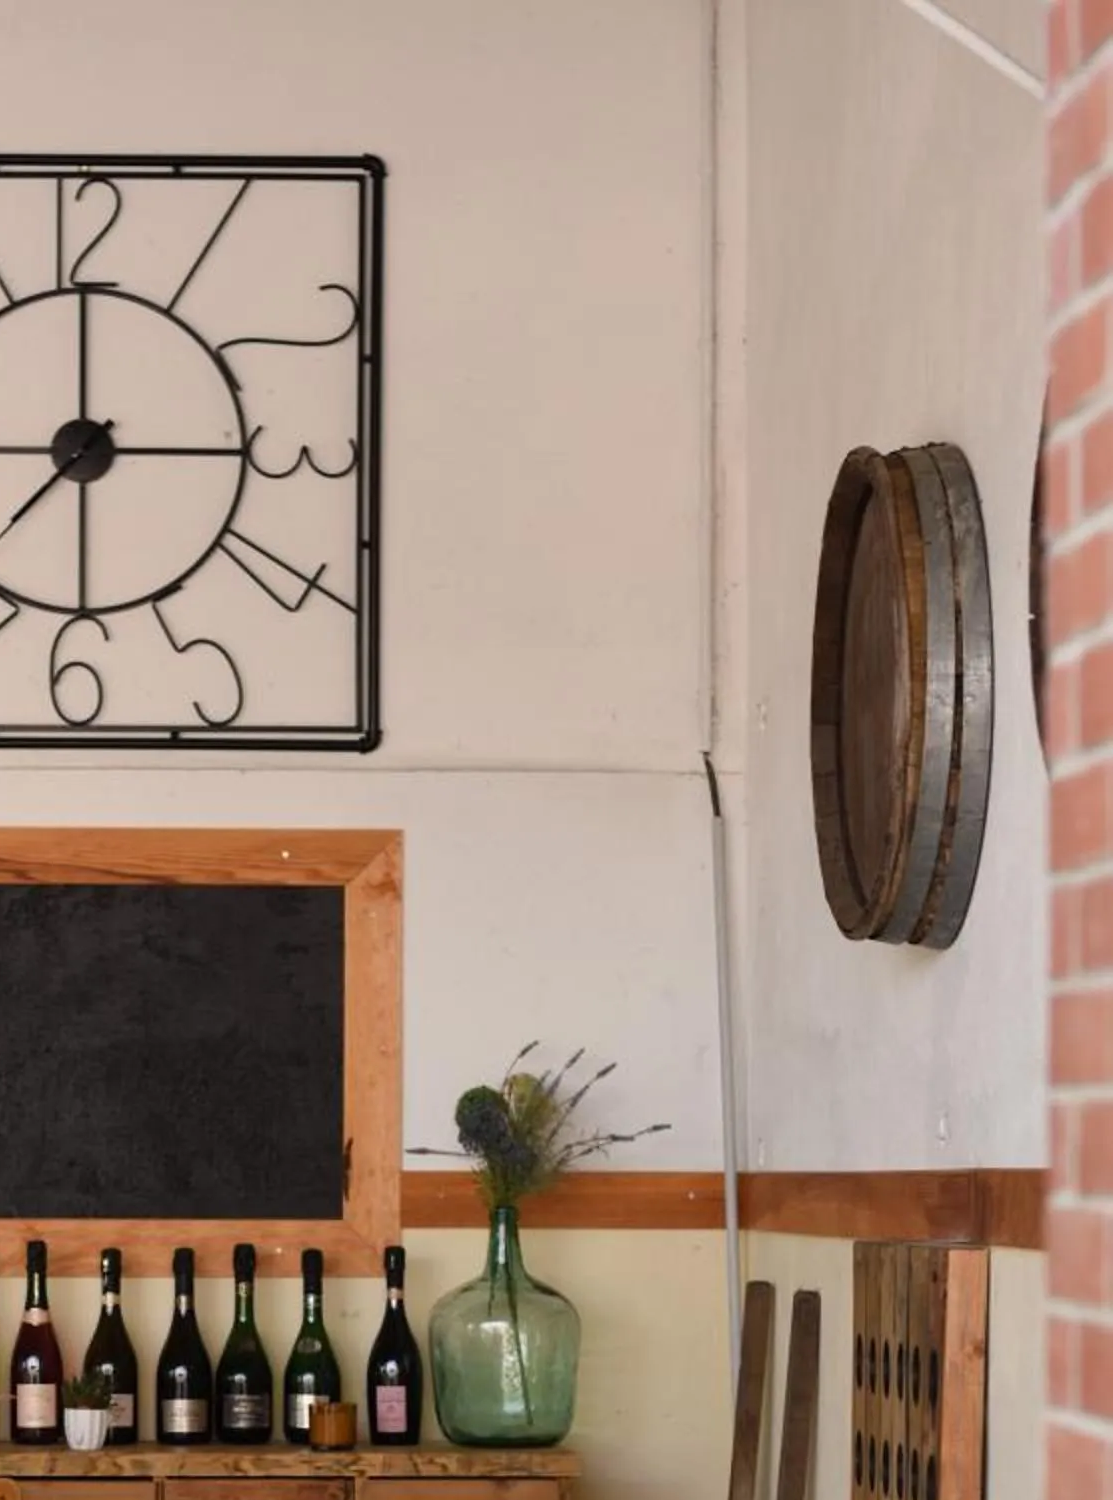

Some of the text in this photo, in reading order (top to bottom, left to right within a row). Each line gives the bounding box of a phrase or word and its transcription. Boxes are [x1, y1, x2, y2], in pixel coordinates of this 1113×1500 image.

[57, 177, 122, 290] 12
[215, 285, 360, 391] 2
[247, 425, 359, 478] 3
[217, 528, 359, 613] 4
[50, 615, 110, 726] 6
[152, 584, 244, 727] 5
